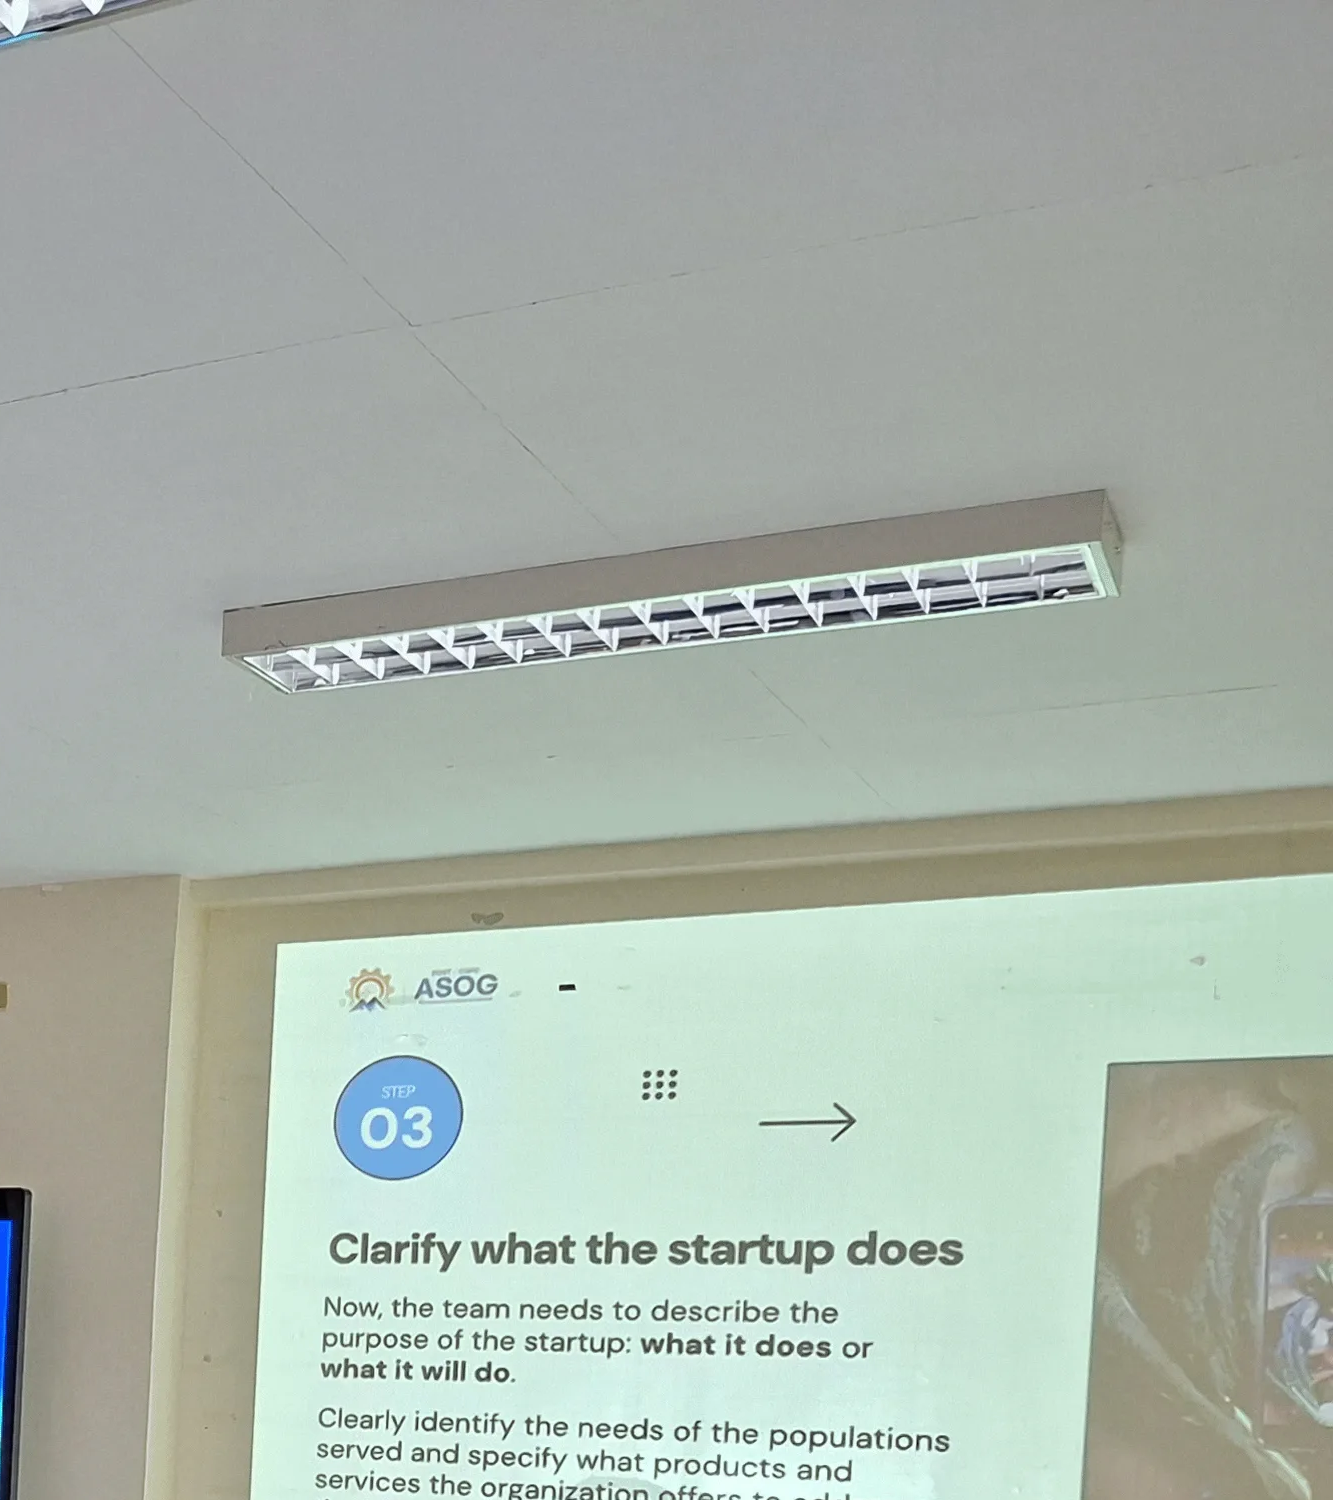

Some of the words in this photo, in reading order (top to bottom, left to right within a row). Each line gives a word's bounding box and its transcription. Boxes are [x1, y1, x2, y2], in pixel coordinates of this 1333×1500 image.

[414, 973, 499, 1001] ASOG
[381, 1085, 416, 1099] STEP
[360, 1106, 433, 1149] 03
[329, 1232, 462, 1272] Clarify
[471, 1232, 576, 1265] what
[586, 1232, 657, 1265] the
[668, 1234, 835, 1274] startup
[847, 1230, 964, 1266] does
[323, 1297, 383, 1320] Now,
[392, 1297, 433, 1319] the
[442, 1299, 510, 1320] team
[519, 1299, 603, 1320] needs
[612, 1302, 641, 1321] to
[651, 1299, 780, 1323] describe
[790, 1300, 839, 1324] the
[322, 1330, 429, 1354] purpose
[437, 1329, 464, 1350] of
[472, 1329, 515, 1351] the
[524, 1333, 632, 1359] startup:
[640, 1333, 716, 1356] what
[725, 1333, 746, 1356] it
[755, 1334, 831, 1358] does
[842, 1339, 874, 1359] or
[320, 1358, 387, 1380] what
[394, 1359, 413, 1380] it
[421, 1360, 466, 1382] will
[474, 1361, 516, 1383] do.
[318, 1407, 406, 1435] Clearly
[414, 1410, 515, 1440] identify
[524, 1415, 569, 1437] the
[578, 1418, 663, 1442] needs
[673, 1420, 702, 1442] of
[711, 1421, 758, 1444] the
[769, 1425, 950, 1453] populations
[316, 1440, 402, 1462] served
[411, 1443, 459, 1464] and
[468, 1446, 568, 1475] specify
[576, 1449, 645, 1473] what
[654, 1454, 786, 1480] products
[797, 1460, 853, 1482] and
[314, 1470, 420, 1494] services
[429, 1474, 472, 1496] the
